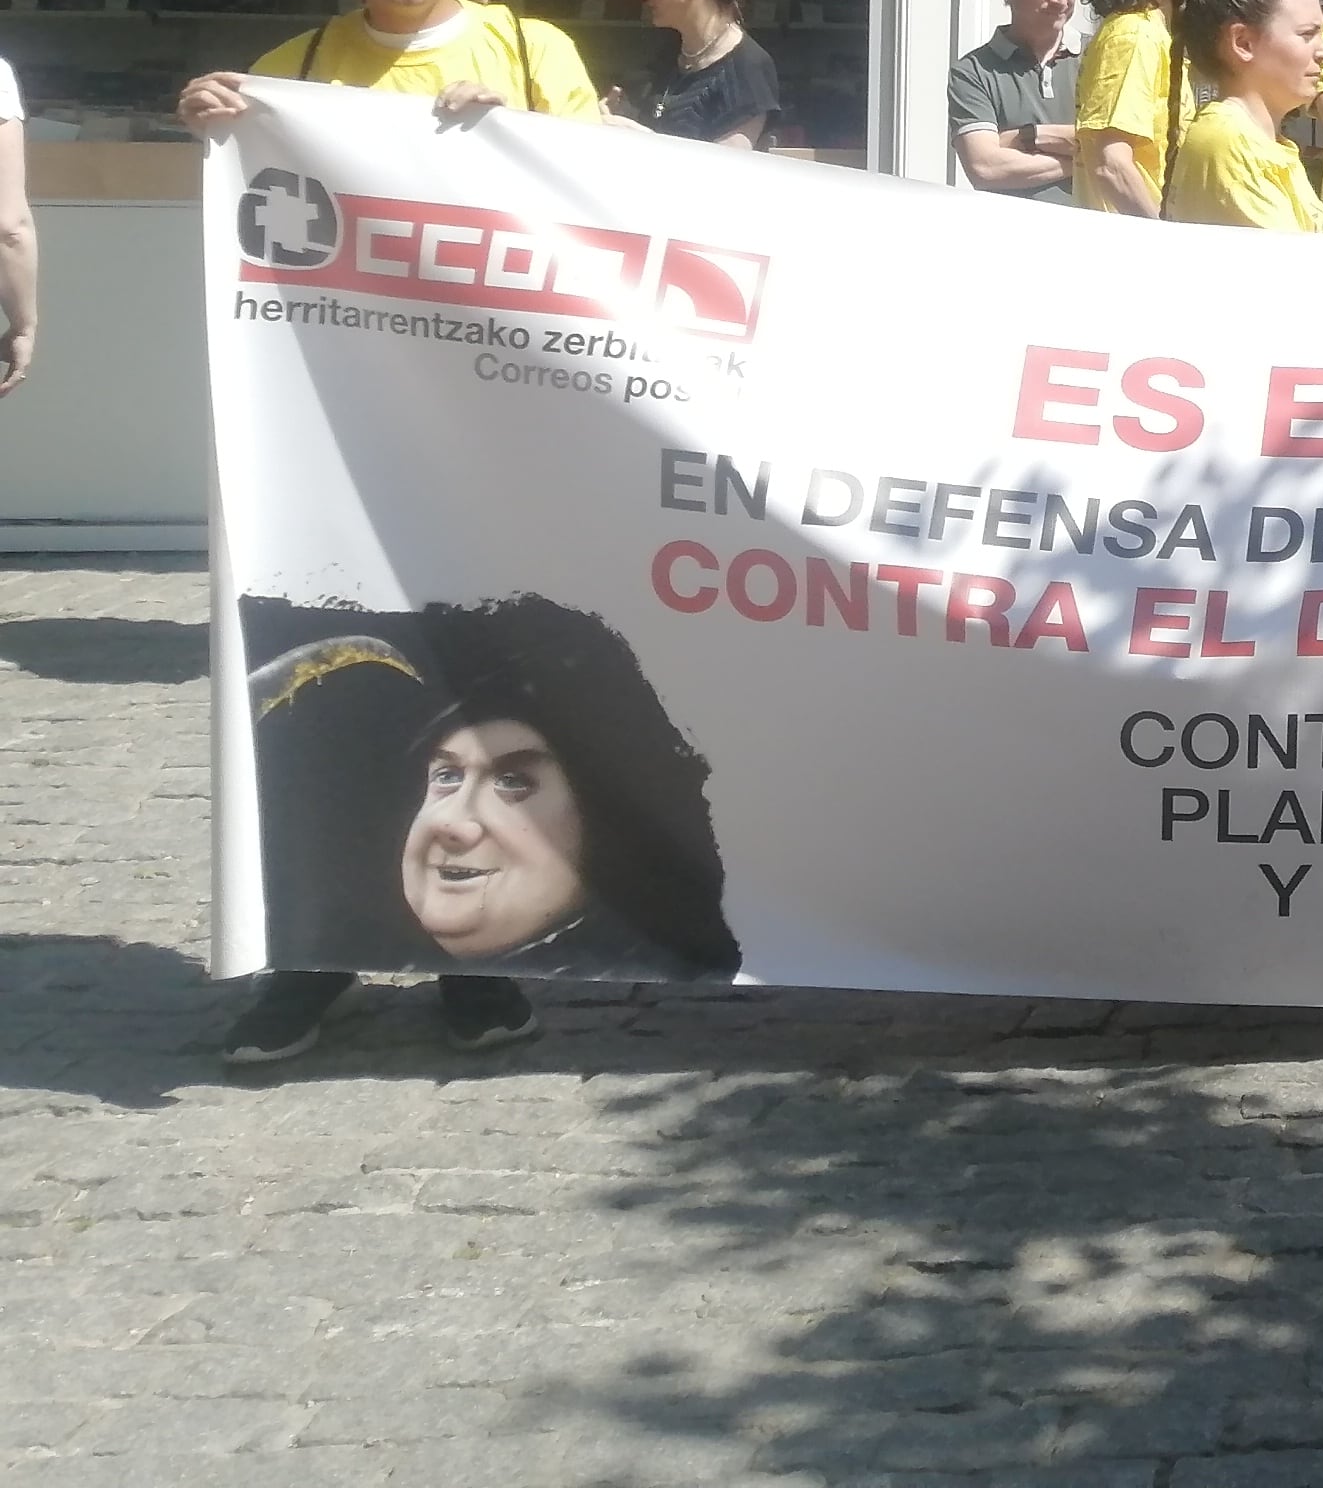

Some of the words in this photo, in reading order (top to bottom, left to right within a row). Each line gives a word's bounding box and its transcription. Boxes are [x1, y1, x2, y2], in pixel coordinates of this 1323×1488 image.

[233, 291, 531, 351] herritarrentzako
[474, 353, 613, 396] Correos
[542, 327, 746, 380] zerbiak
[1011, 344, 1206, 454] ES
[659, 448, 772, 522] EN
[800, 469, 1218, 562] DEFENSA
[650, 540, 1090, 654] CONTRA
[1127, 587, 1257, 659] EL
[1259, 863, 1313, 918] Y
